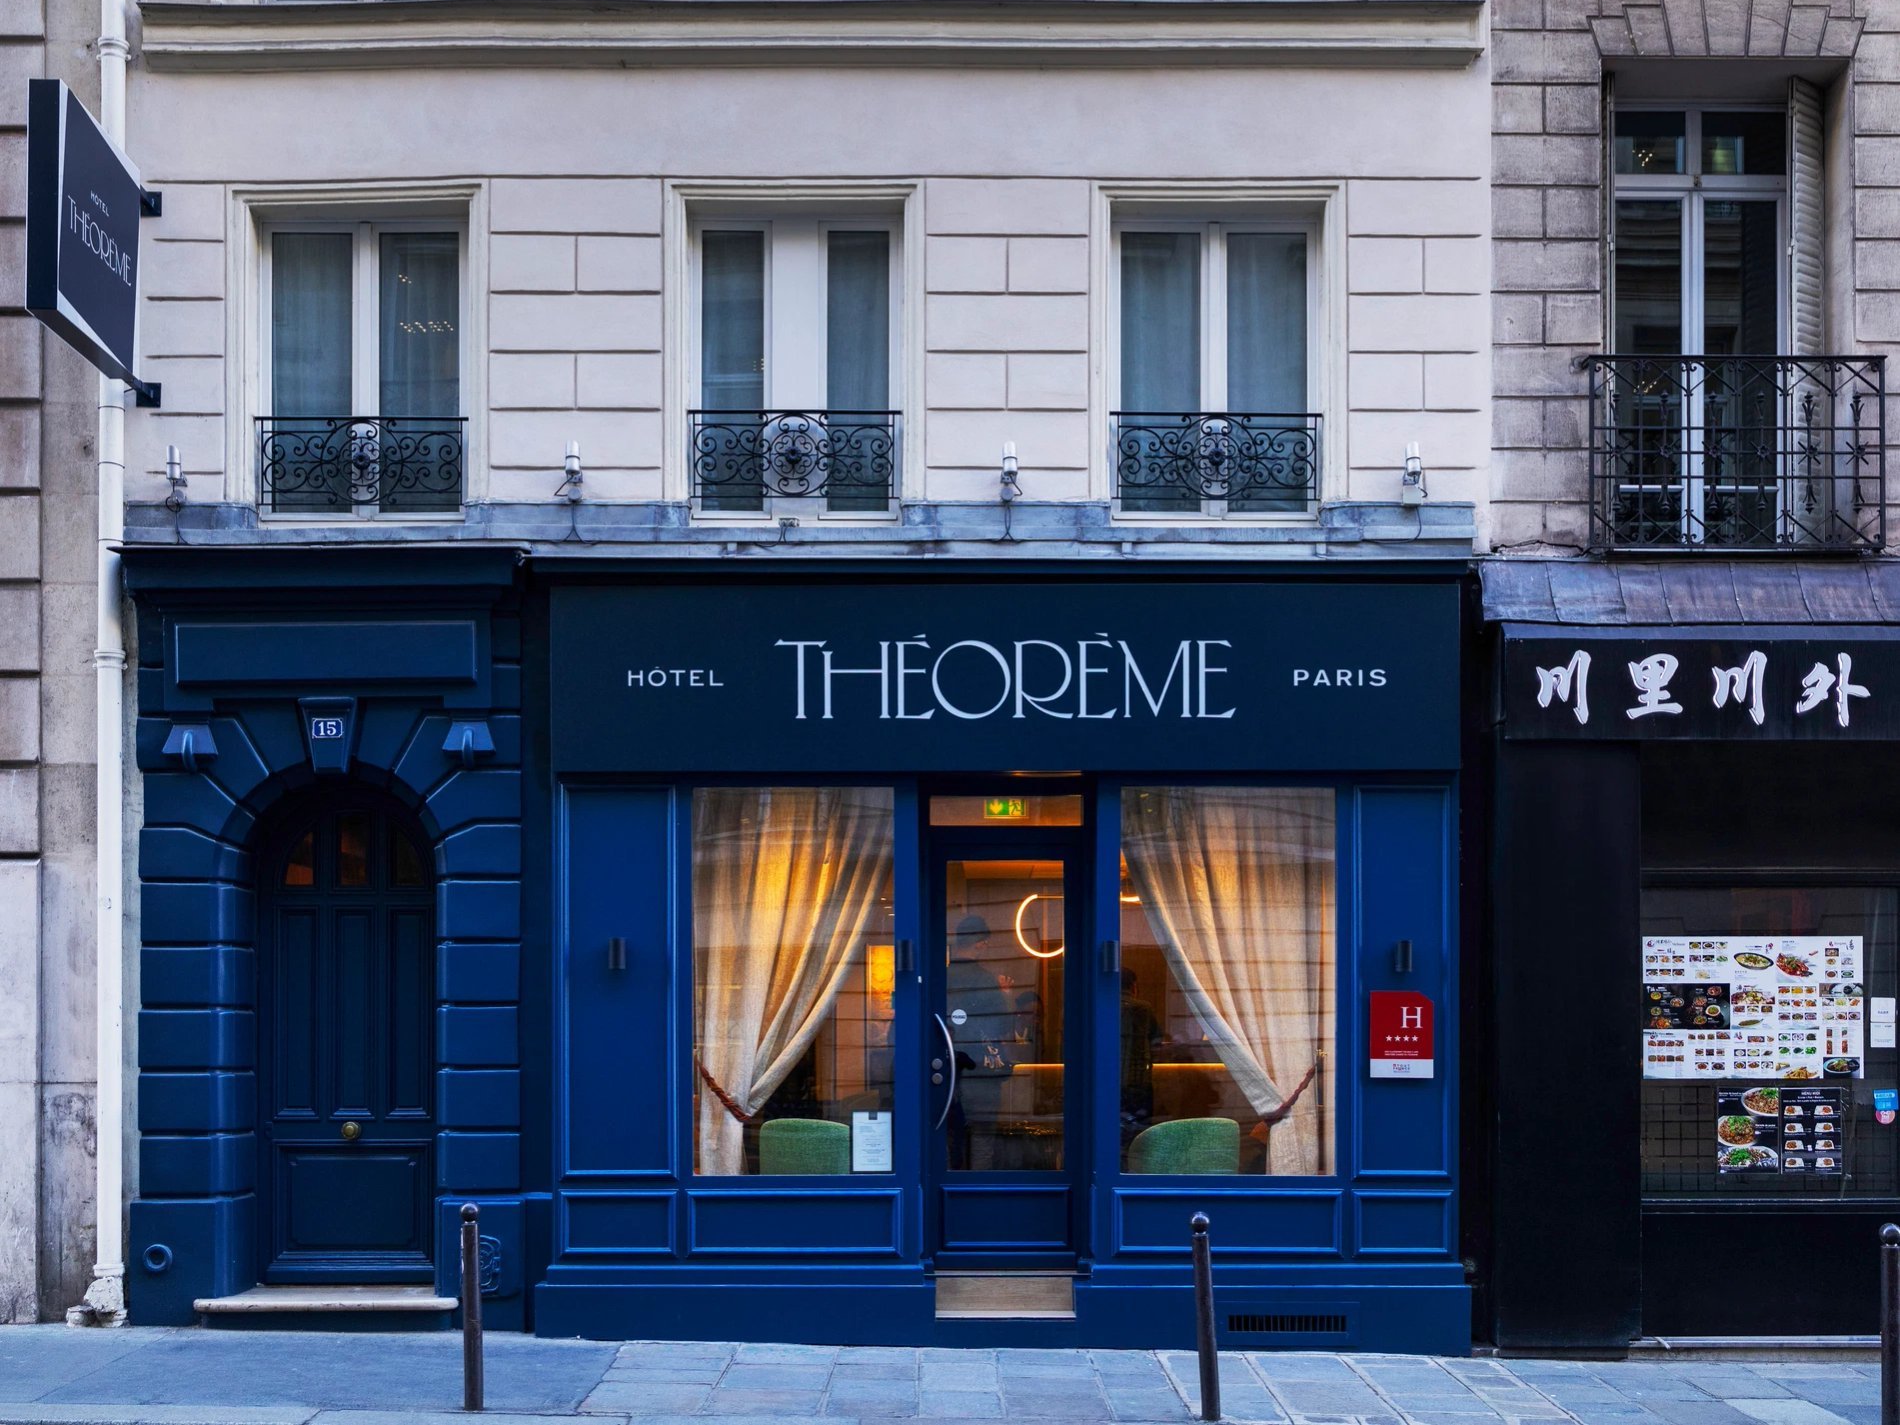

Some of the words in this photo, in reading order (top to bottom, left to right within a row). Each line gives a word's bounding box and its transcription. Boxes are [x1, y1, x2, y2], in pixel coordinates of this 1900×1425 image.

[67, 194, 132, 287] THÉORÈME
[627, 666, 725, 687] HÔTEL
[773, 632, 1237, 720] THÉORÈME
[1292, 668, 1388, 687] PARIS
[1535, 649, 1872, 728] 川里川外
[318, 721, 337, 736] 15
[1400, 1006, 1424, 1029] H
